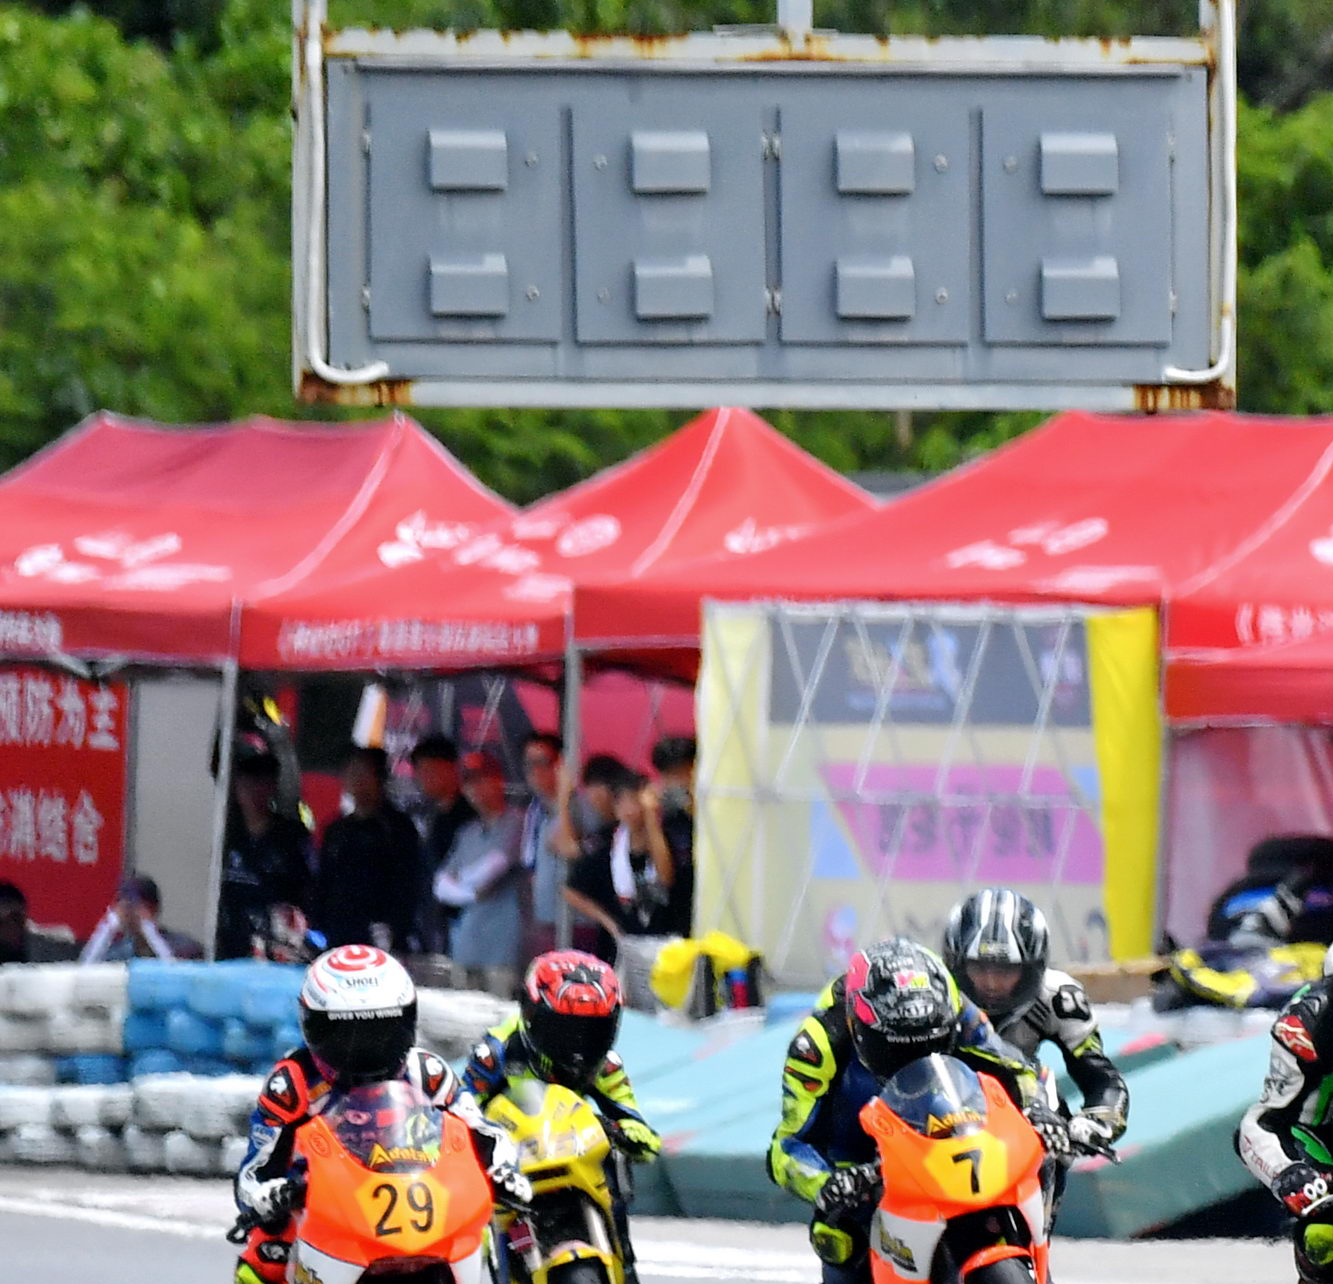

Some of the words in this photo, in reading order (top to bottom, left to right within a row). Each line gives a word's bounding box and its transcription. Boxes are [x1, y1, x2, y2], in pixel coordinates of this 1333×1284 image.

[355, 1010, 375, 1020] YOU
[952, 1149, 982, 1195] 7
[372, 1182, 434, 1237] 29
